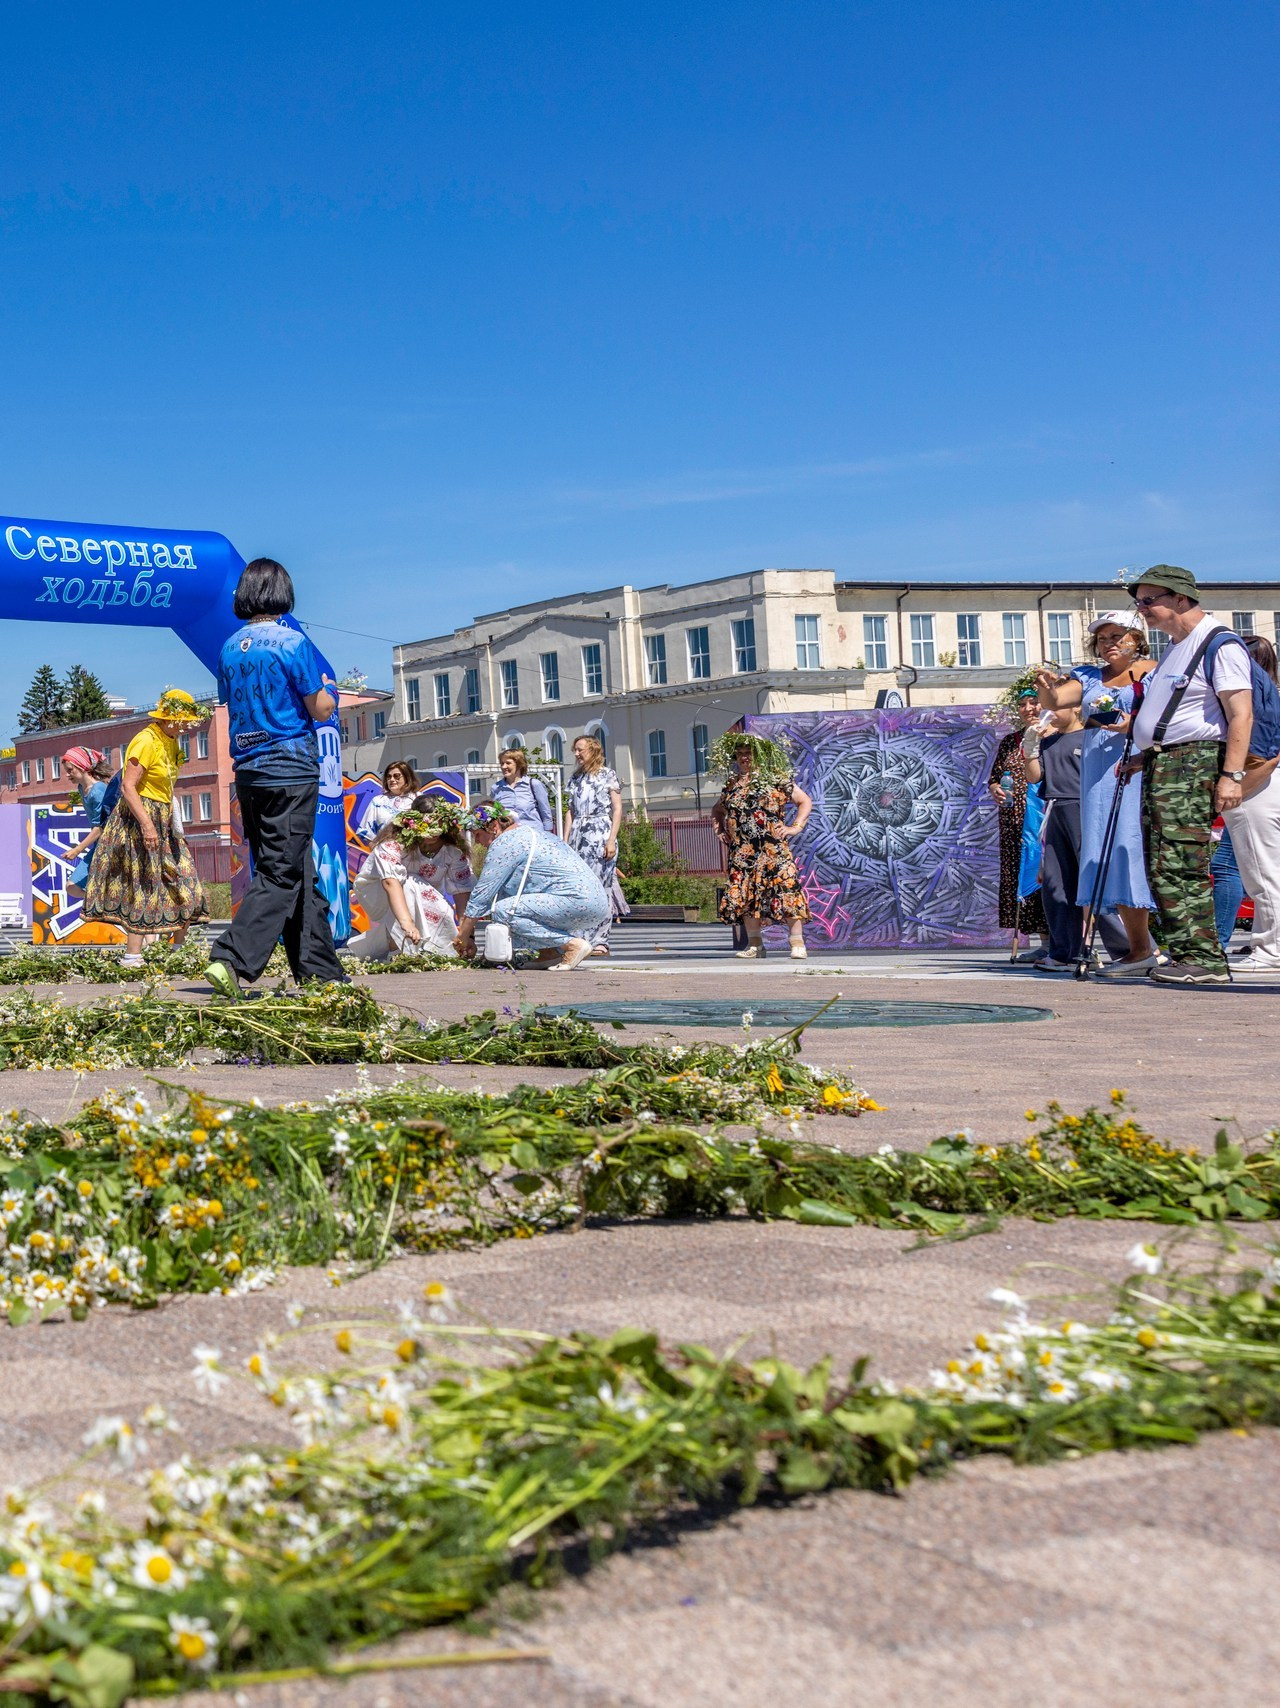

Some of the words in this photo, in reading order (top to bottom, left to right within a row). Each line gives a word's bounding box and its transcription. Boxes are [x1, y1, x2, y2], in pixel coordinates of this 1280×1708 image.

[5, 525, 197, 577] Северная
[35, 569, 173, 610] ходьба
[256, 639, 285, 649] 2024
[223, 659, 277, 682] ORDIC
